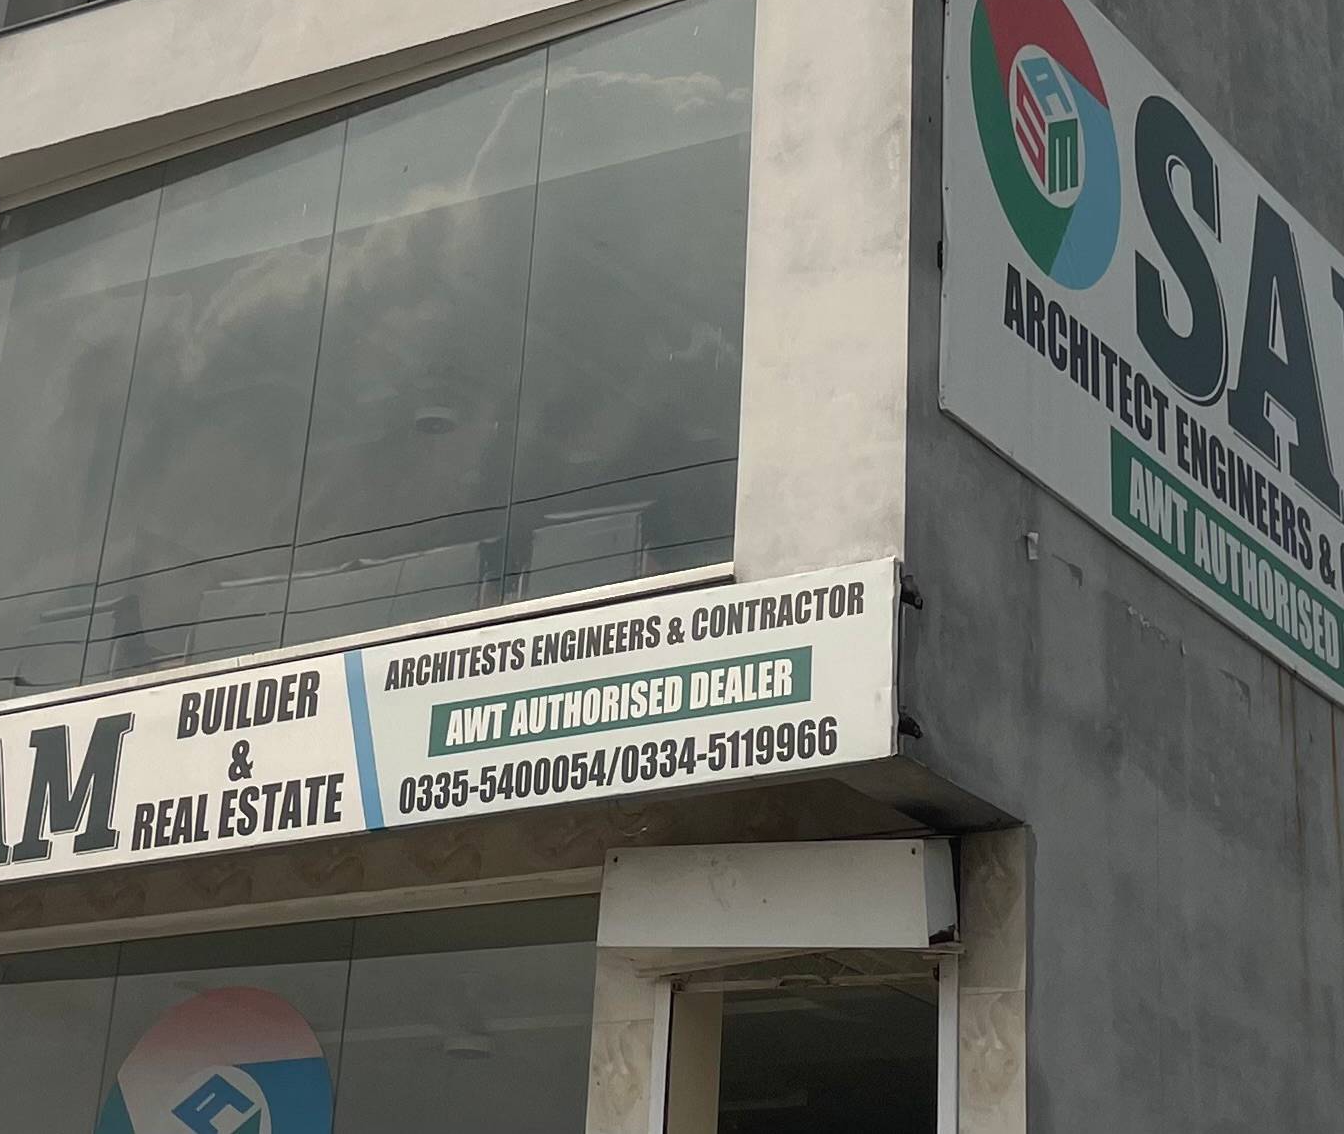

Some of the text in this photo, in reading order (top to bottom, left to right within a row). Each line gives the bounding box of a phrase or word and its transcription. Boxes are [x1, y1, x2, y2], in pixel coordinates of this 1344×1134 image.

[1003, 263, 1169, 455] ARCHITECT
[1175, 404, 1314, 571] ENGINEERS
[1318, 534, 1338, 590] &
[1129, 456, 1189, 556] AWT
[1193, 507, 1341, 670] AUTHORISED
[385, 581, 865, 692] ARCHITESTS ENGINEERS & CONTRACTOR
[176, 670, 321, 740] BUILDER
[445, 658, 793, 747] AWT AUTHORISED DEALER
[227, 739, 254, 782] &
[398, 716, 838, 816] 0335-5400054/0334-5119966
[130, 773, 345, 851] REAL ESTATE
